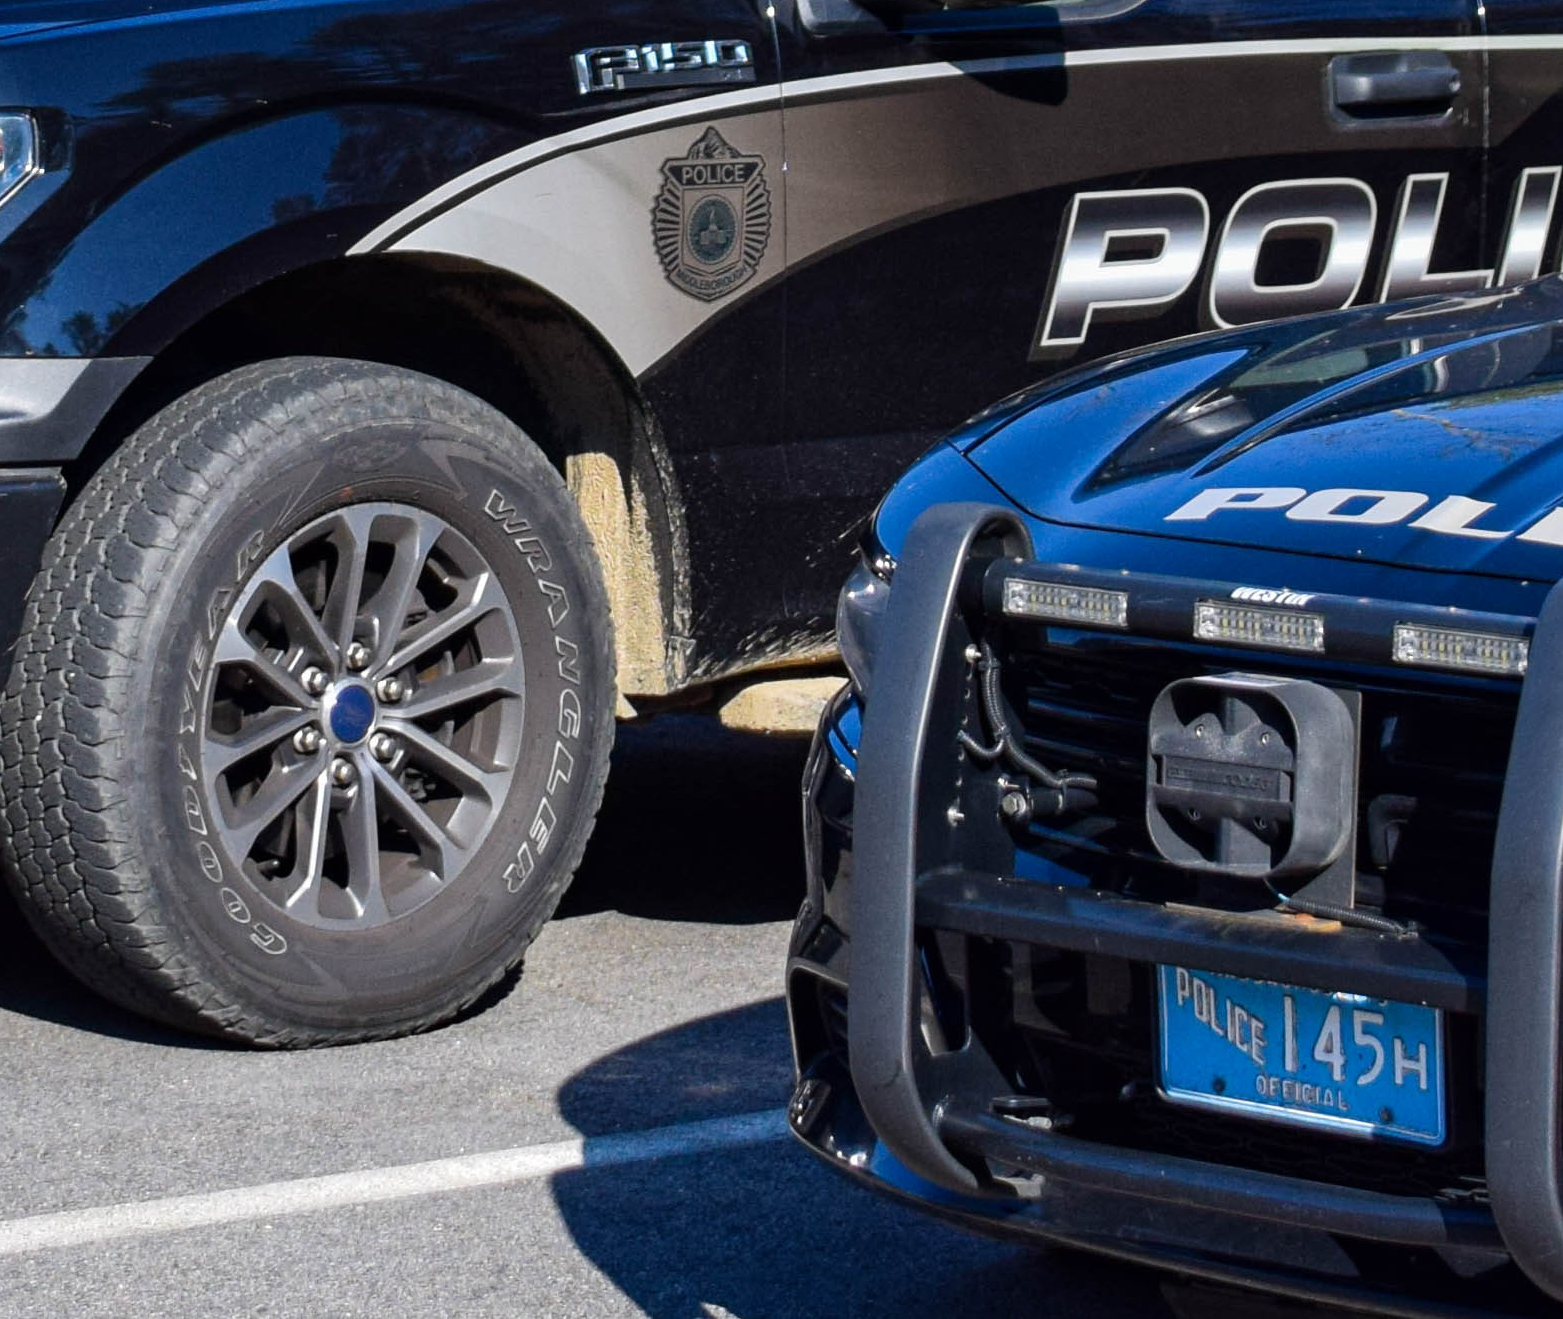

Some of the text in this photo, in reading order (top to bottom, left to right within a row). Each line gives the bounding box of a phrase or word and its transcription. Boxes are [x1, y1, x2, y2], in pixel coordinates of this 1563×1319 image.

[682, 164, 745, 184] POLICE
[484, 488, 582, 894] WRANGLER
[179, 528, 287, 956] GOODYEAR
[1175, 966, 1267, 1066] POLICE
[1256, 1074, 1350, 1111] OFFICIAL
